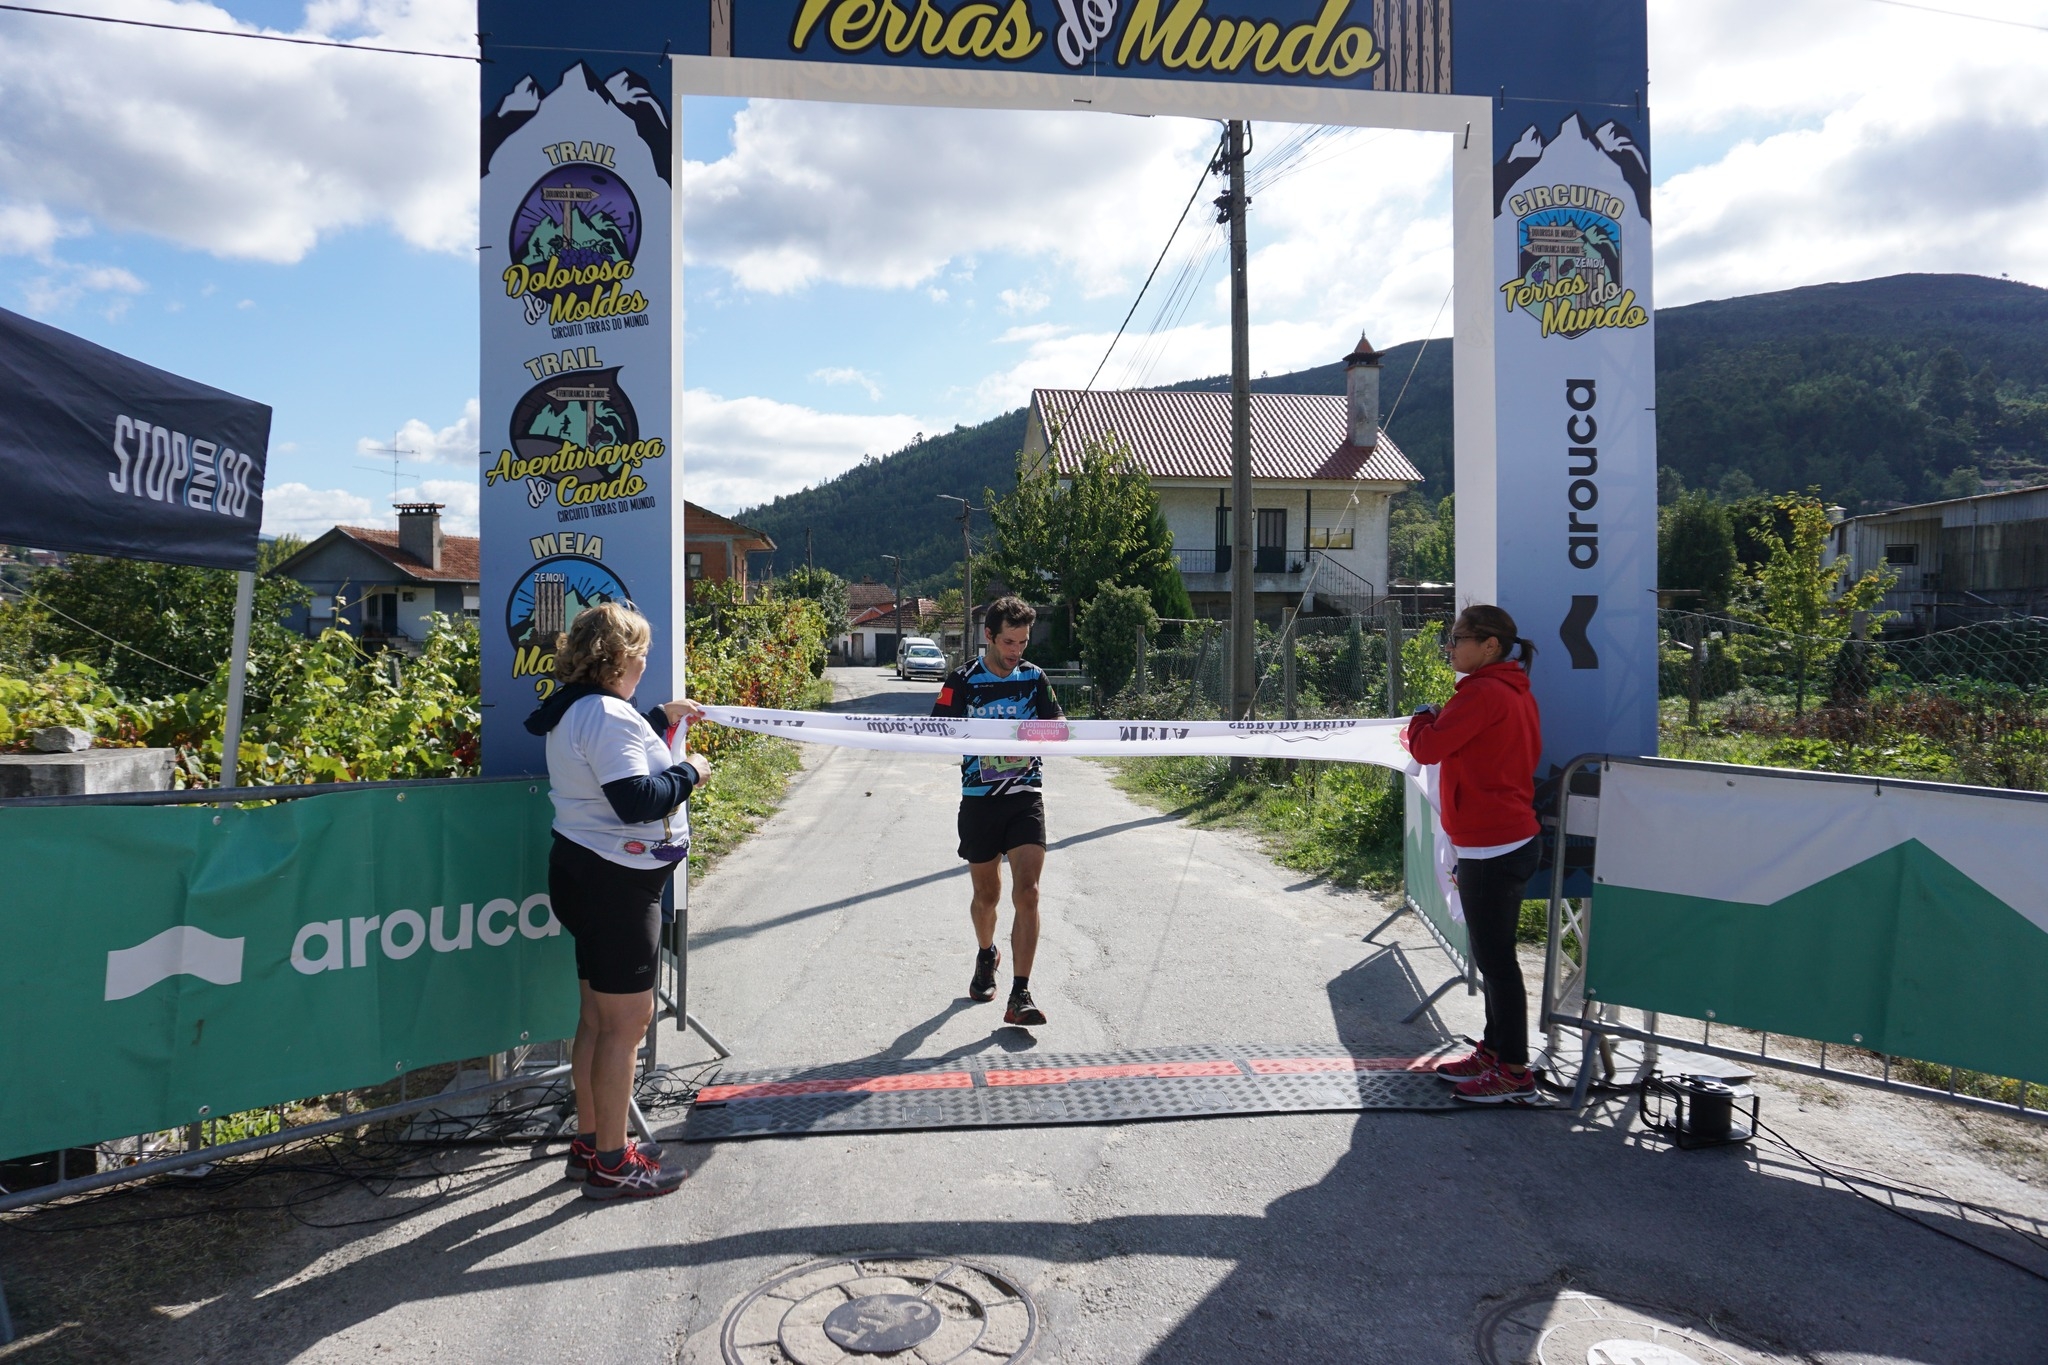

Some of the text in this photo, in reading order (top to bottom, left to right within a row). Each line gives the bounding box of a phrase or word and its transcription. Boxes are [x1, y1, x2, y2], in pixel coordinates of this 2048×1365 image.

[1115, 0, 1382, 77] Mundo
[543, 141, 616, 168] TRAIL
[1509, 184, 1625, 219] CIRCUITO
[503, 256, 634, 297] Dolorosa
[1500, 273, 1621, 312] Terras do
[522, 282, 649, 325] de Moldes
[1541, 289, 1649, 338] Mundo
[551, 314, 650, 340] CIRCUITO TERRAS DO MUNDO
[524, 346, 603, 380] TRAIL
[109, 414, 252, 518] STOP AND GO
[486, 437, 665, 487] Aventurança
[1565, 378, 1599, 570] arouca
[526, 463, 647, 508] de Cando
[557, 496, 656, 523] CIRCUITO TERRAS DO MUNDO
[530, 532, 603, 560] MEIA
[534, 572, 565, 583] ZEMOU
[289, 892, 562, 976] arouca
